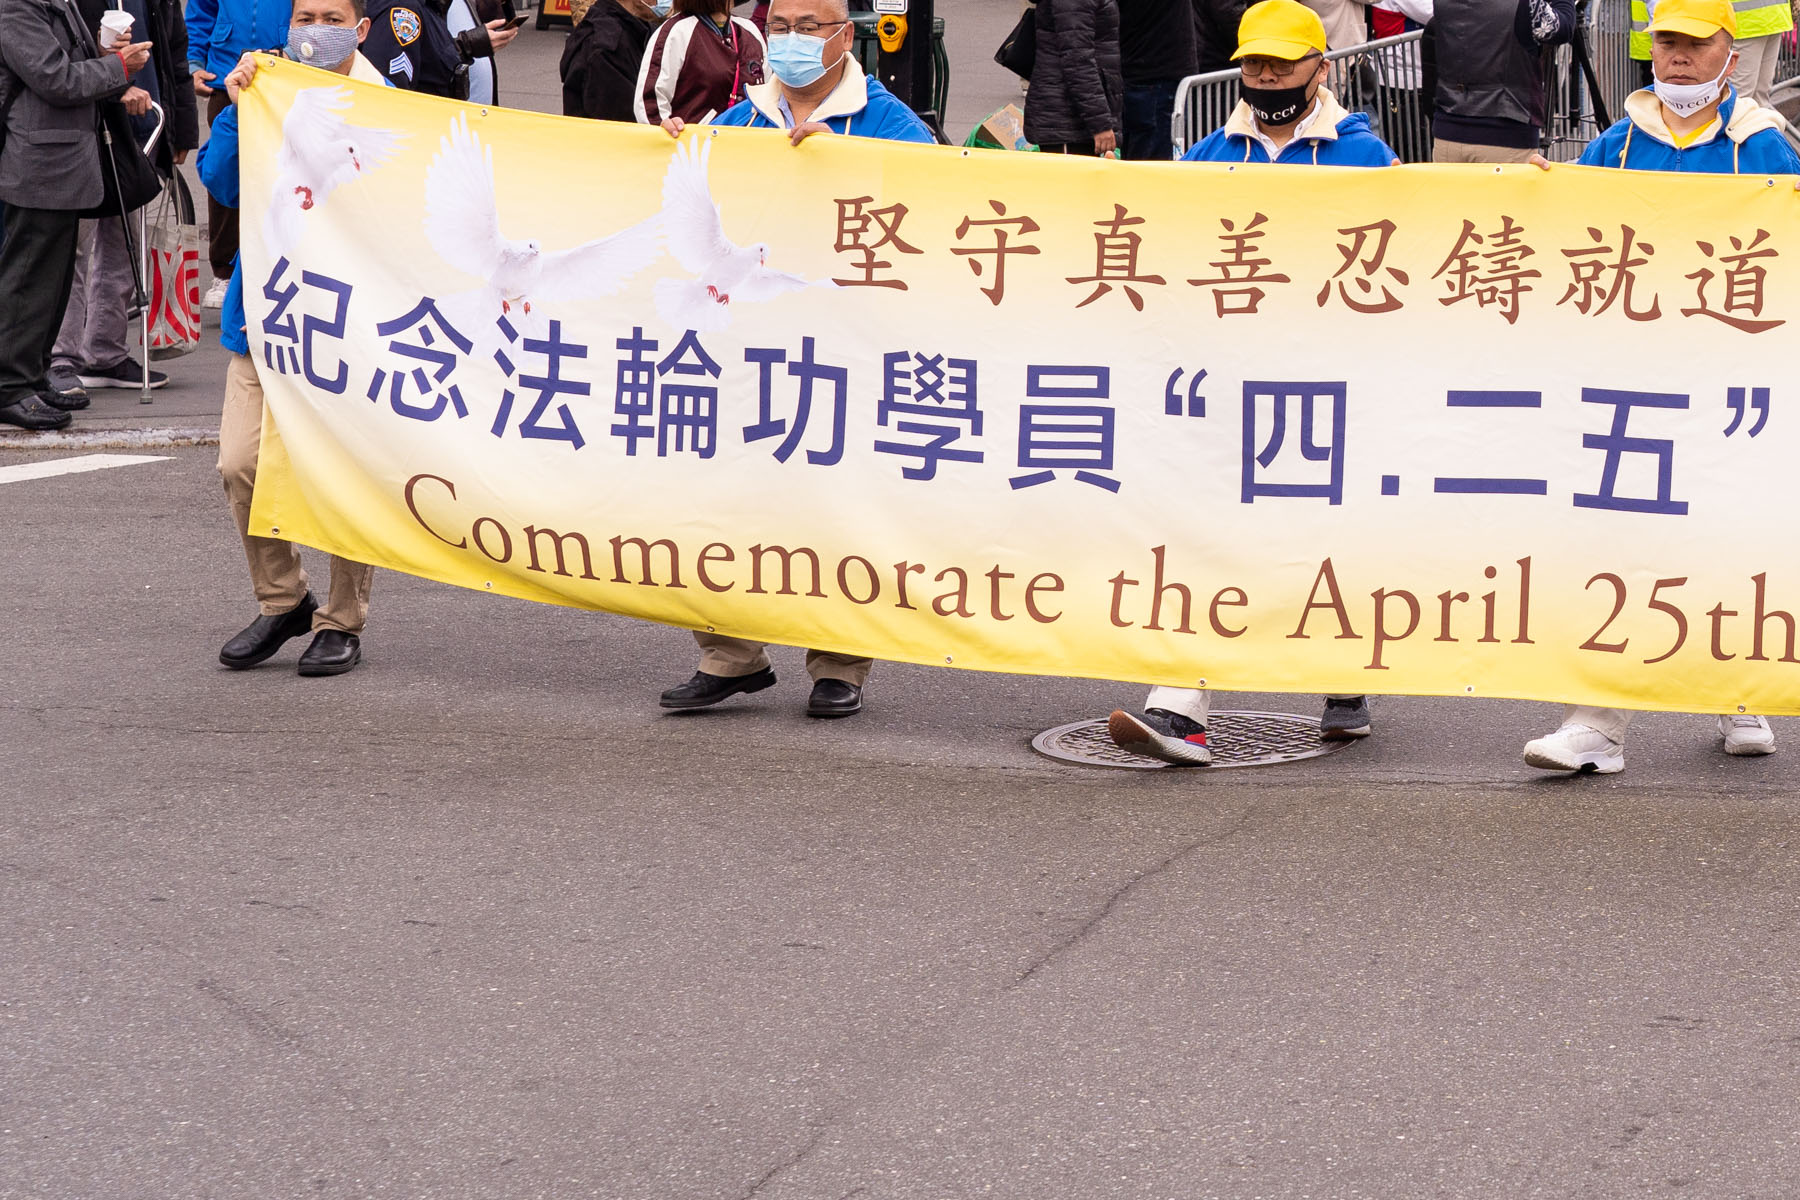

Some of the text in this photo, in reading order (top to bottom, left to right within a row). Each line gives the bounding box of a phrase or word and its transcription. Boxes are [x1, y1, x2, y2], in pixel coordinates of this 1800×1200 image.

[402, 472, 1066, 626] Commemorate
[1109, 544, 1249, 639] the
[1286, 555, 1536, 671] April
